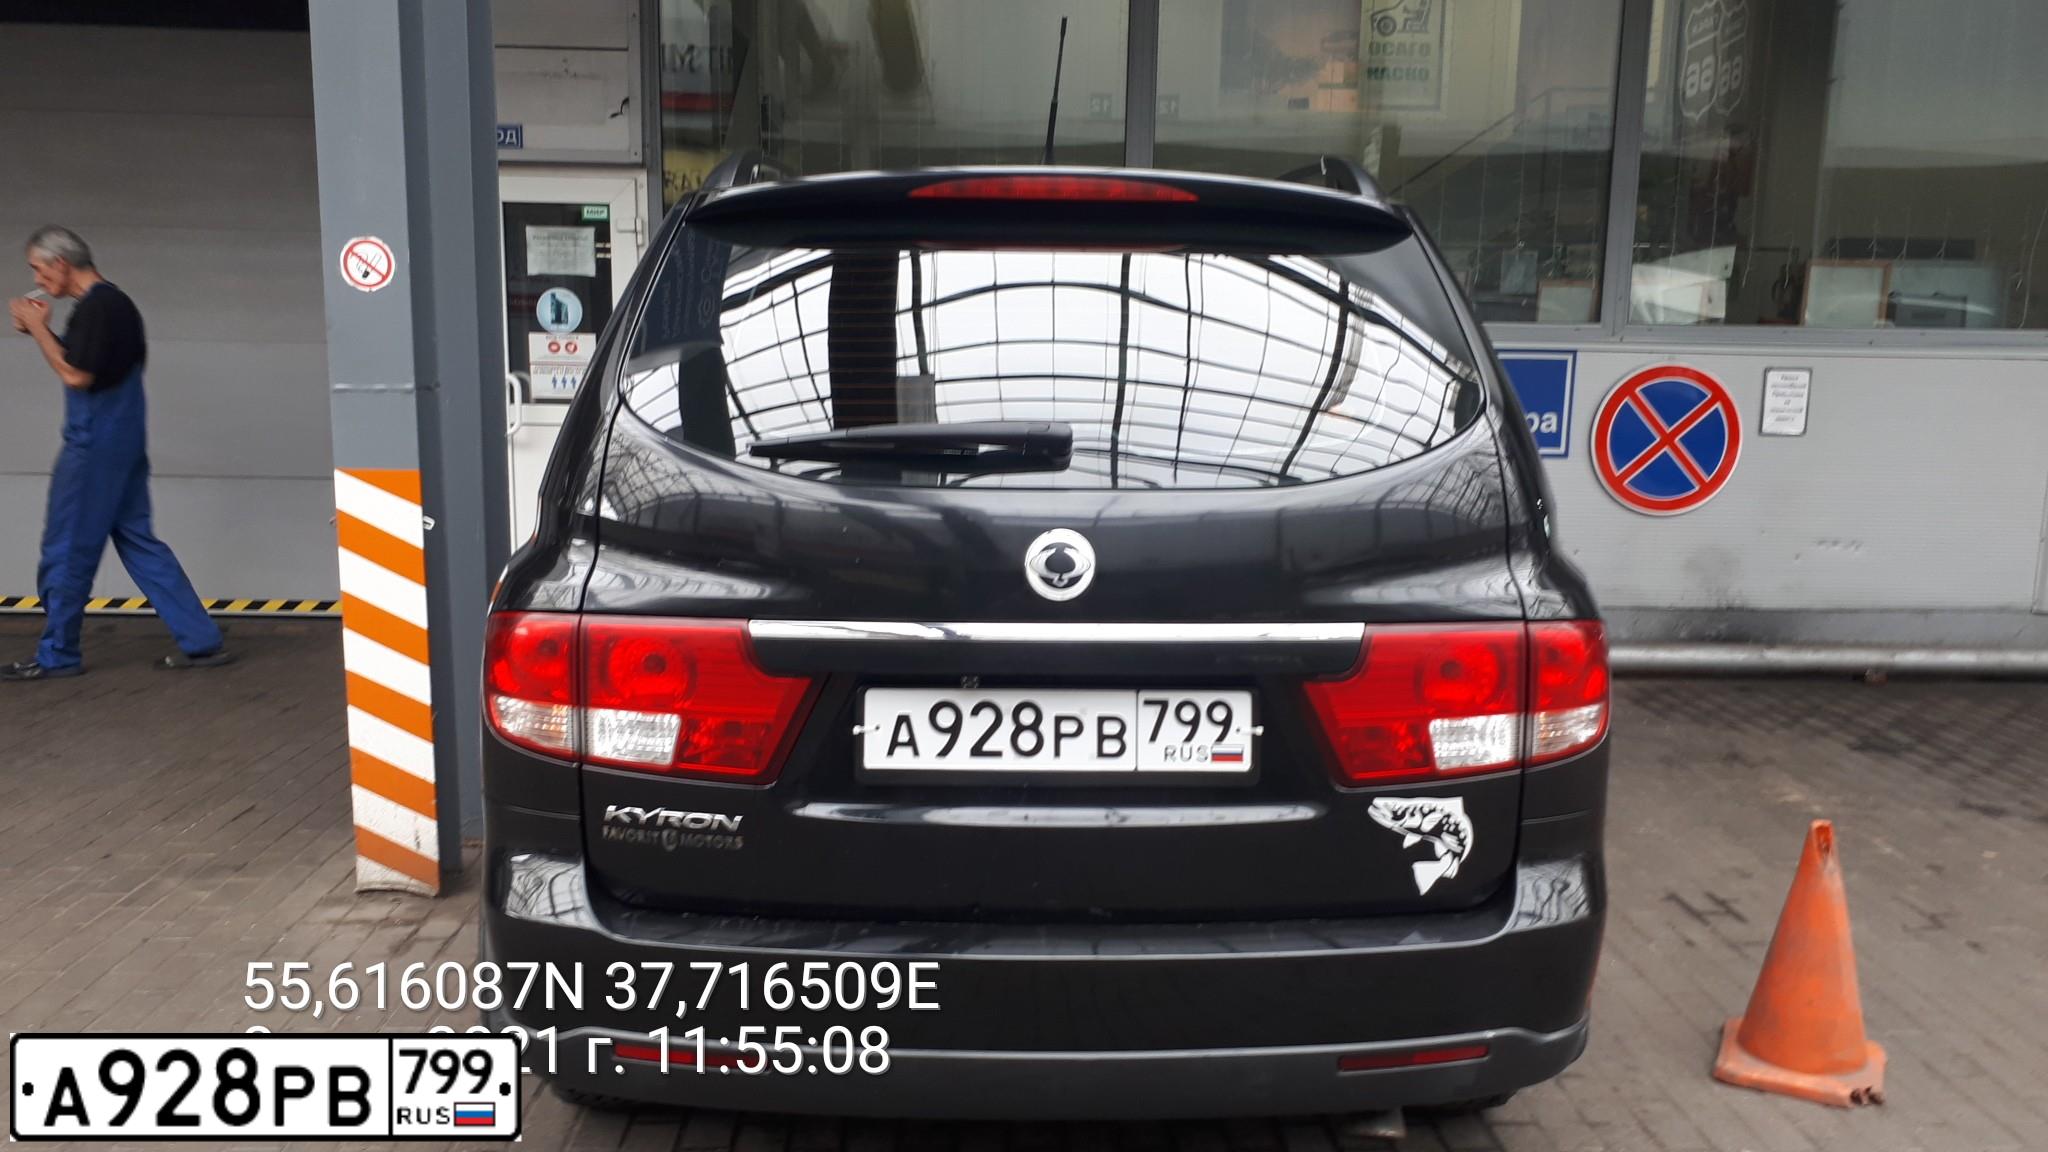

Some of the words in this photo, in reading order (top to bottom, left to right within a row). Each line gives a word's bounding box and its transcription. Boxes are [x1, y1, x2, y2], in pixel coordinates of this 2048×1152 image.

[886, 700, 1127, 758] А928РВ
[1143, 700, 1233, 743] 799
[1164, 745, 1209, 763] RUS
[603, 804, 744, 832] KYRON
